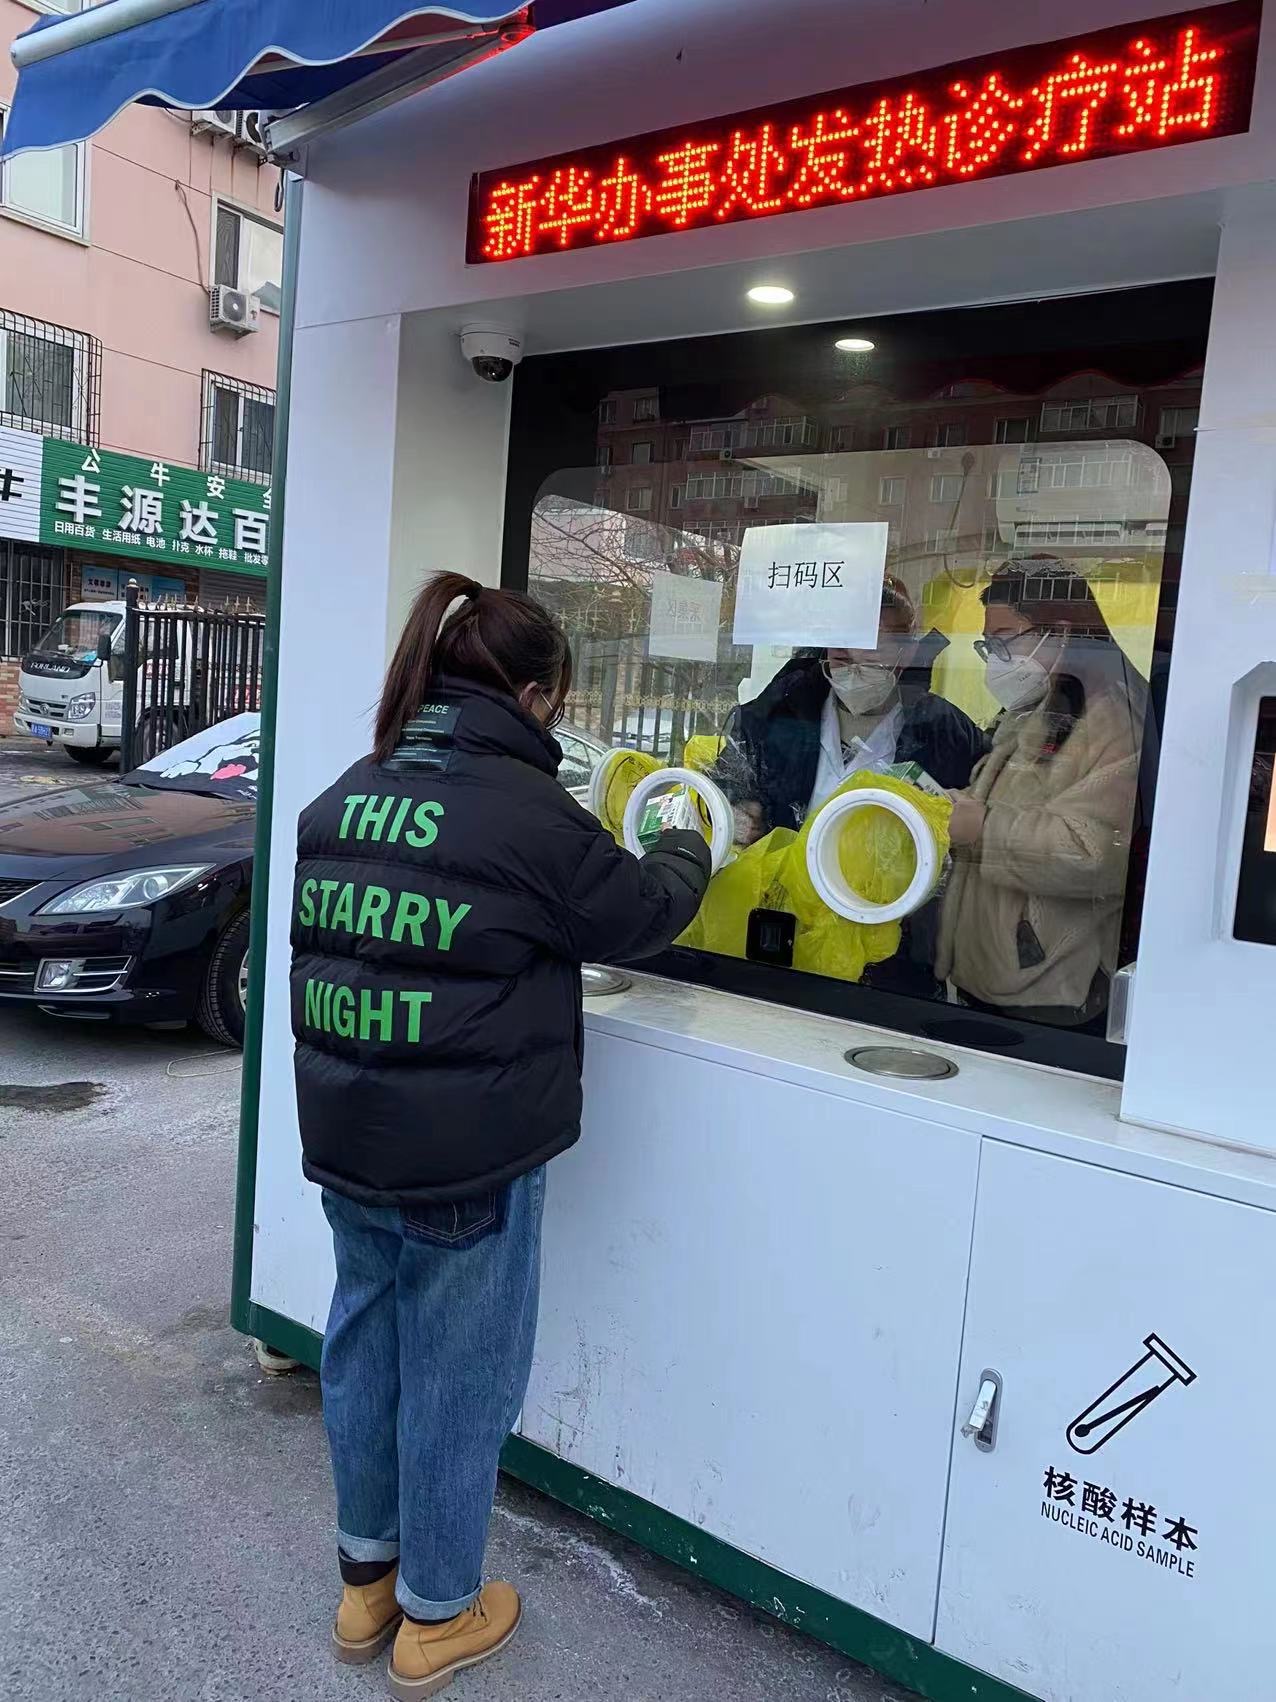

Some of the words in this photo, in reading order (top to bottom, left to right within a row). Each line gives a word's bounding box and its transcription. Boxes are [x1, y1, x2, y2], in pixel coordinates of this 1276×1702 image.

[482, 27, 1221, 259] 新华办事处发热诊疗站
[54, 520, 96, 538] 日用百货
[102, 528, 141, 546] 生活用纸
[146, 536, 166, 549] 电池
[172, 539, 190, 554] 扑克
[194, 544, 214, 558] 水杯
[218, 547, 238, 561] 拖鞋
[56, 474, 270, 551] 丰源达百
[767, 560, 845, 590] 扫码区
[338, 794, 445, 848] THIS
[298, 878, 472, 951] STARRY
[304, 978, 433, 1043] NIGHT
[1041, 1501, 1099, 1538] NUCLEIC
[1100, 1526, 1134, 1552] ACID
[1136, 1540, 1196, 1579] SAMPLE
[1042, 1465, 1199, 1552] 核酸样本
